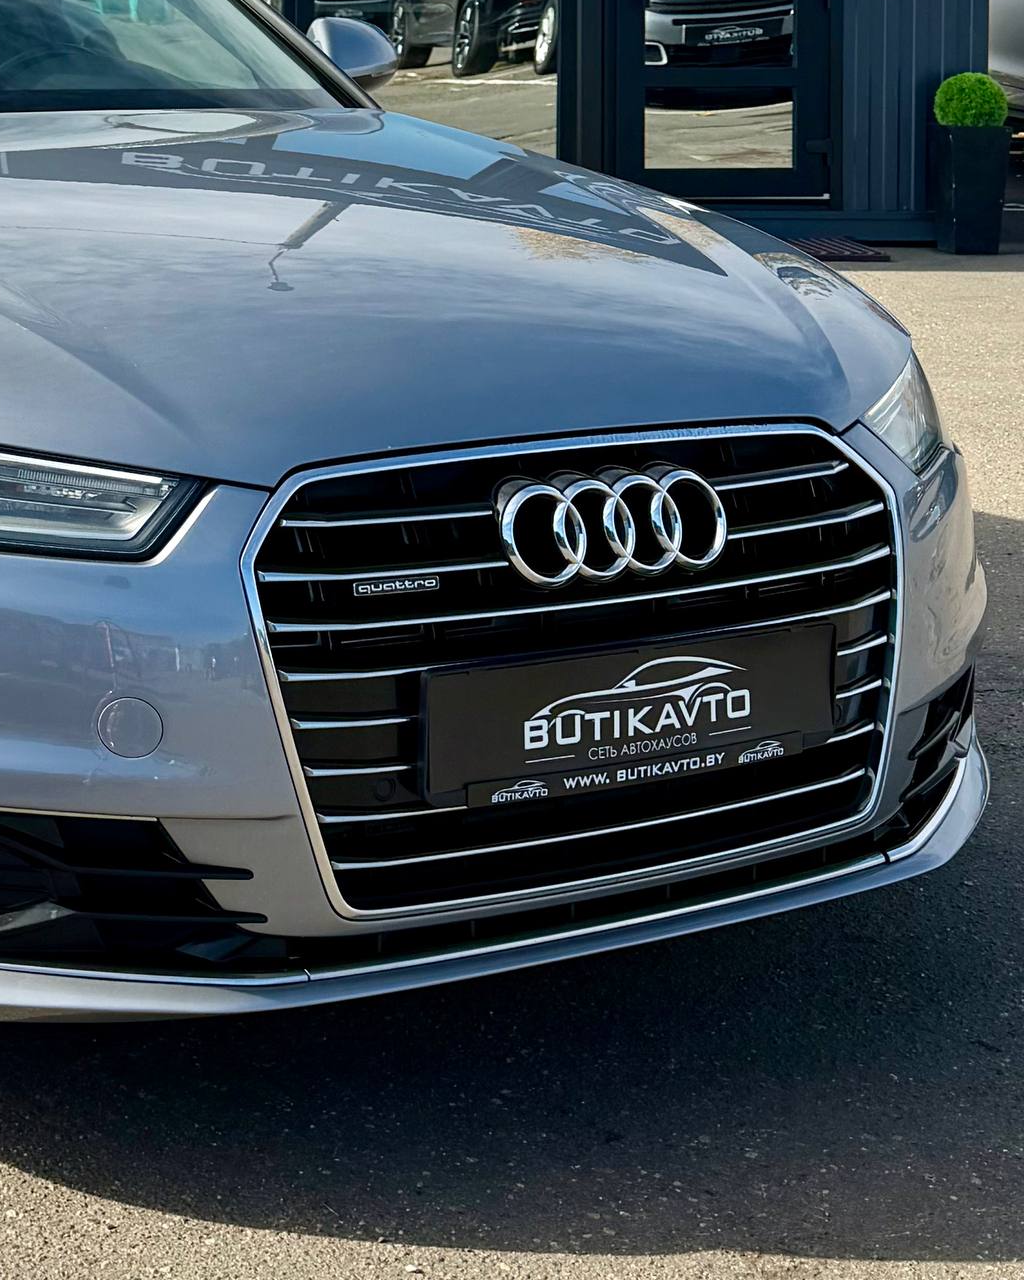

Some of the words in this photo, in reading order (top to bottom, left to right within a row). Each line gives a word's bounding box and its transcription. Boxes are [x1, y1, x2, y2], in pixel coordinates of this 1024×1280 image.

[358, 579, 437, 594] quattro
[524, 688, 751, 751] BUTIKAVTO
[588, 745, 618, 761] СЕТЬ
[621, 732, 698, 756] АВТОХАУСОВ
[737, 748, 784, 764] BUTIKAVTO
[563, 772, 610, 790] WWW.
[616, 752, 726, 783] BUTIKAVTO.BY
[491, 787, 549, 804] BUTIKAVTO
